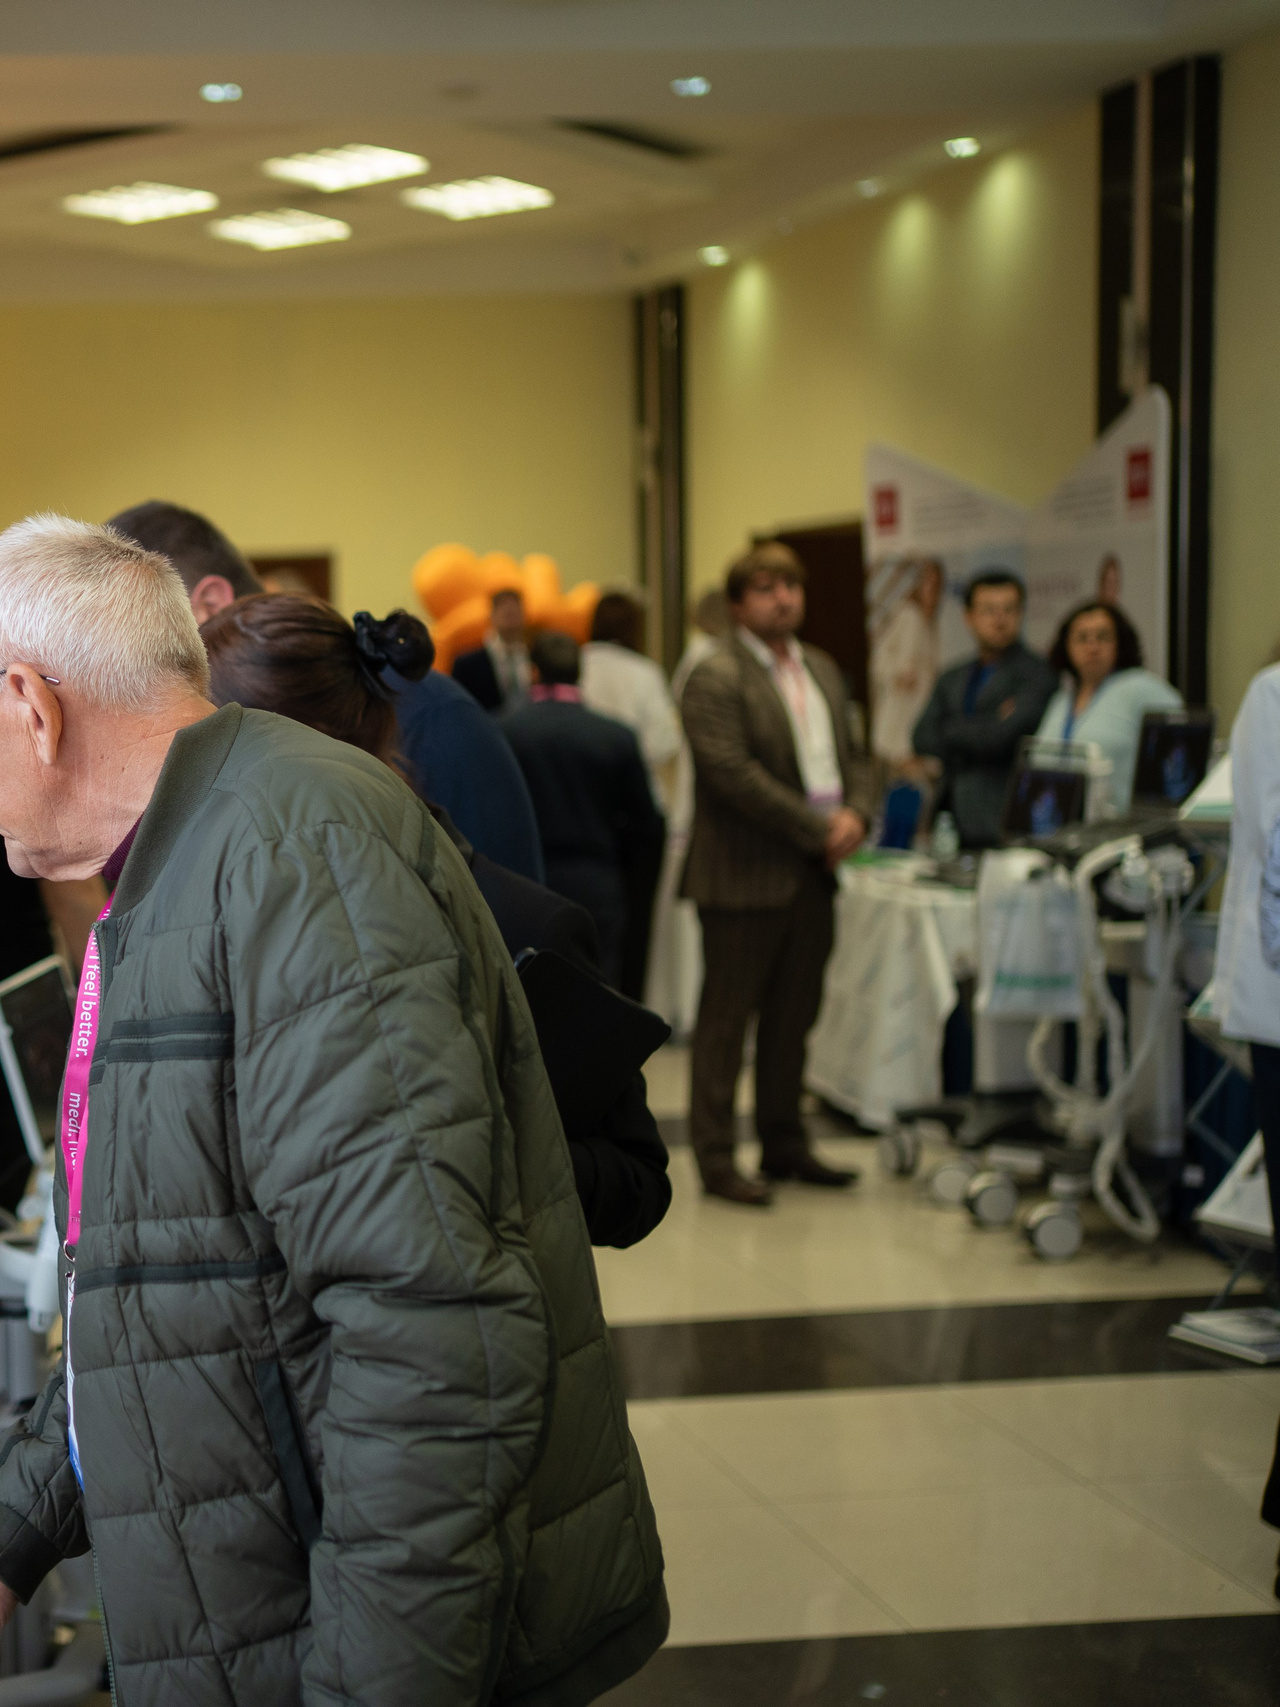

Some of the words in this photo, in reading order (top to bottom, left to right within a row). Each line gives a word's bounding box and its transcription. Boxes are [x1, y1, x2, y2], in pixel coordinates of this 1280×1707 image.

[83, 964, 100, 996] feel
[75, 1001, 96, 1058] better.
[67, 1092, 81, 1137] medi.
